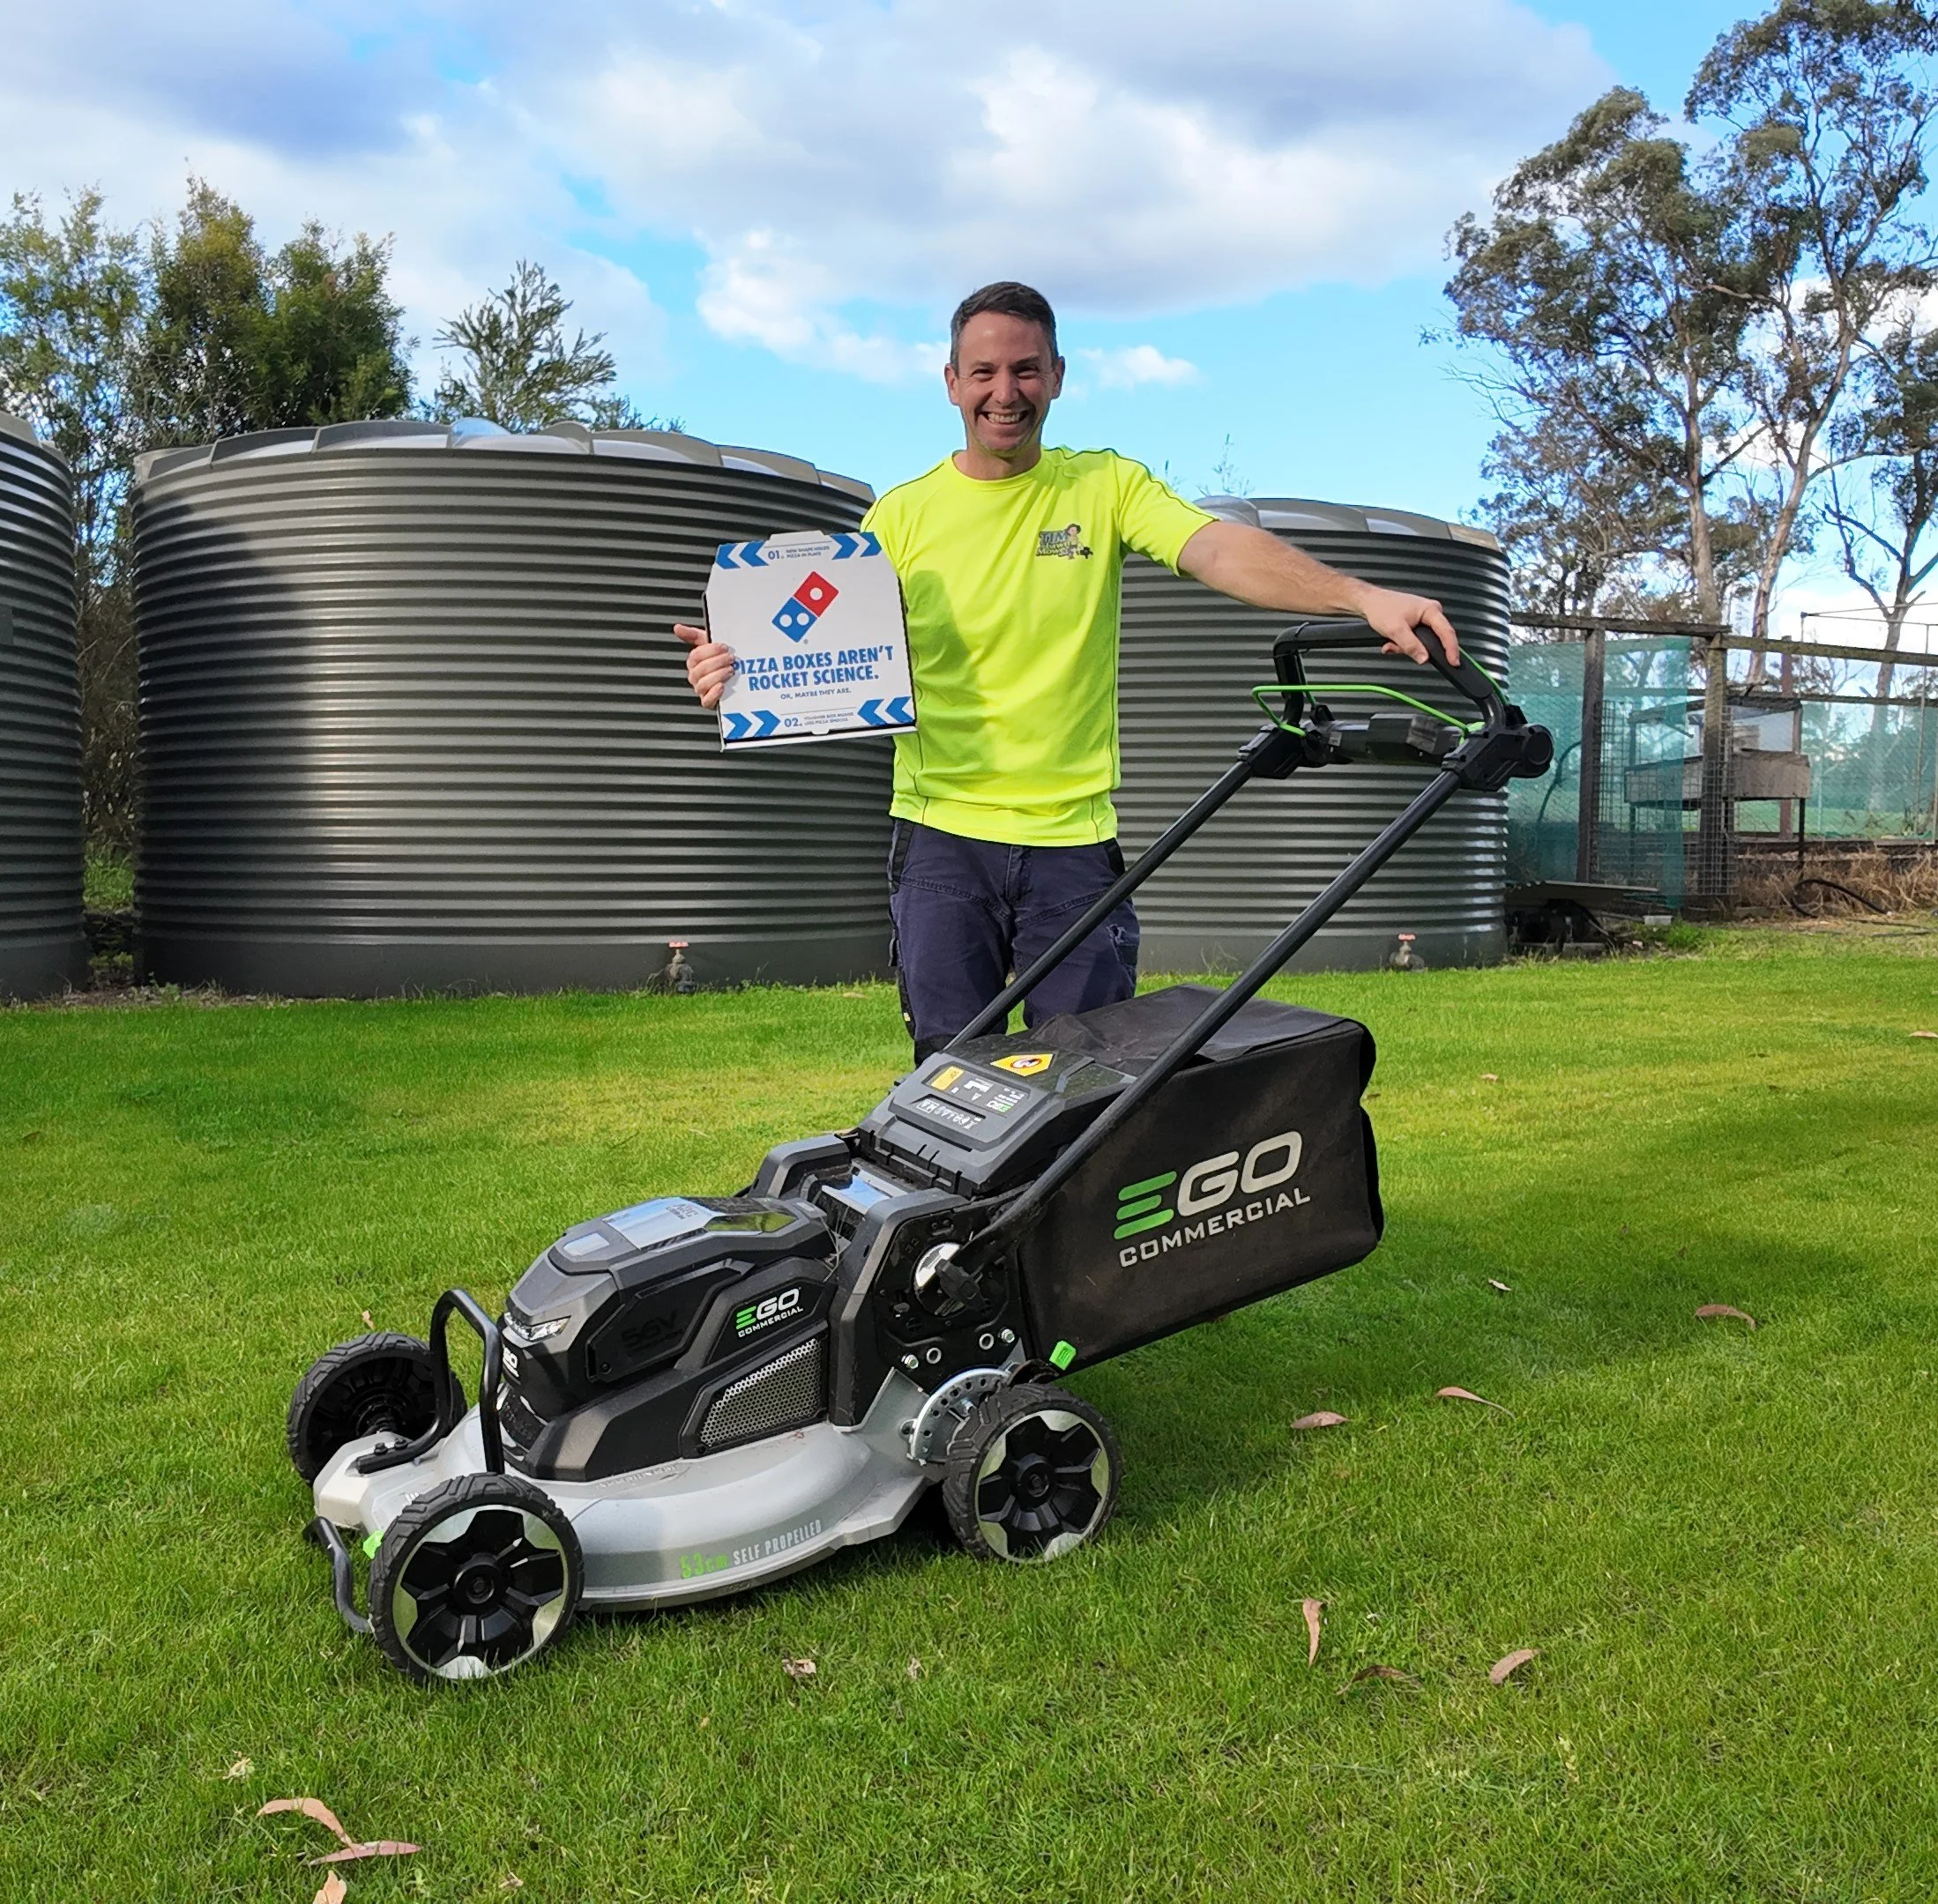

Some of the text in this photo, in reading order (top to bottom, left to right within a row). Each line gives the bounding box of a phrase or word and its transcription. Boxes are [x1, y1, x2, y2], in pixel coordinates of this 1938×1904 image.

[782, 652, 833, 671] BOXES
[837, 645, 893, 666] AREN'T
[749, 665, 879, 691] ROCKET SCIENCE.
[784, 718, 802, 727] 02.
[1114, 1131, 1302, 1240] EGO
[1119, 1187, 1311, 1268] COMMERCIAL
[735, 1288, 800, 1330] EGO
[737, 1305, 804, 1338] COMMERCIAL
[733, 1544, 760, 1566] SELF
[764, 1519, 822, 1555] PROPELLED
